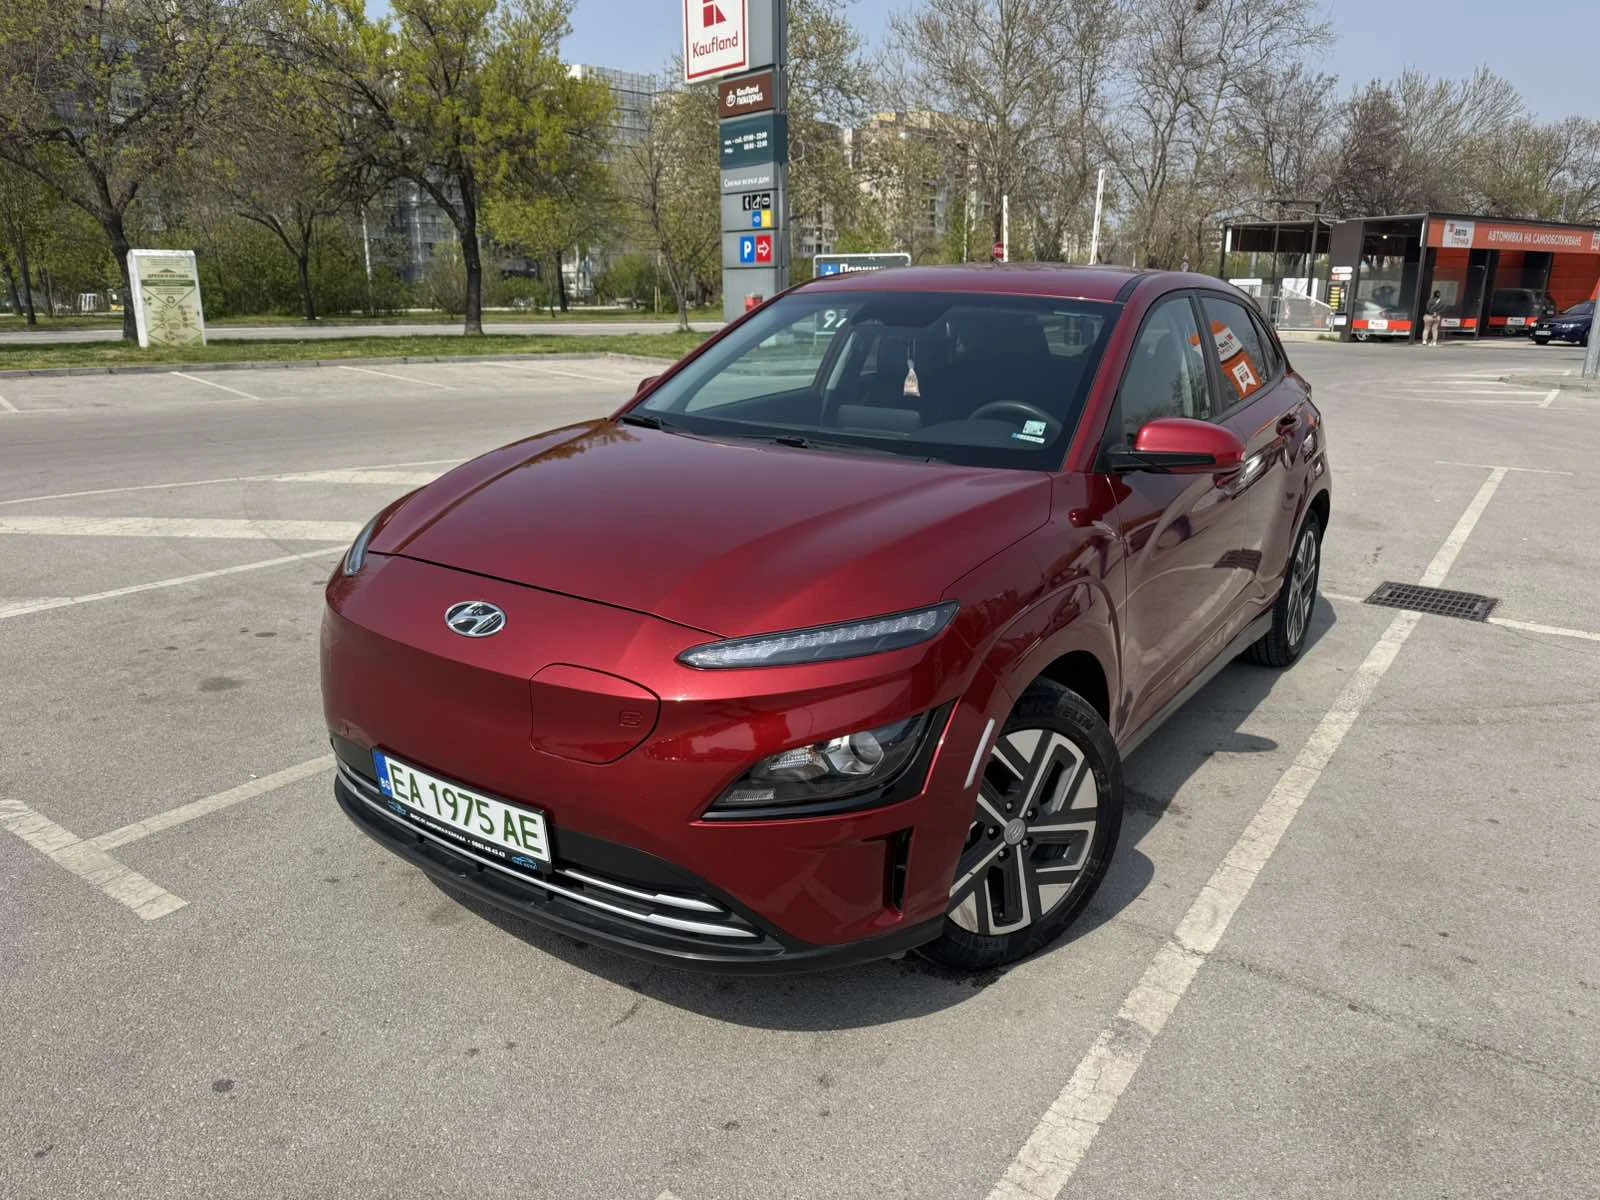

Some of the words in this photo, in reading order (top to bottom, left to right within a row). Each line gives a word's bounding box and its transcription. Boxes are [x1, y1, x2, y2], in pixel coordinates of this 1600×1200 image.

[692, 30, 738, 59] Kaufland
[1487, 229, 1523, 243] АВТОМИВКА
[1523, 232, 1532, 243] НА
[1532, 233, 1583, 247] САМООБСЛУЖВАНЕ
[743, 241, 752, 259] P
[389, 763, 424, 808] EA
[428, 781, 495, 836] 1975
[503, 808, 543, 854] AE
